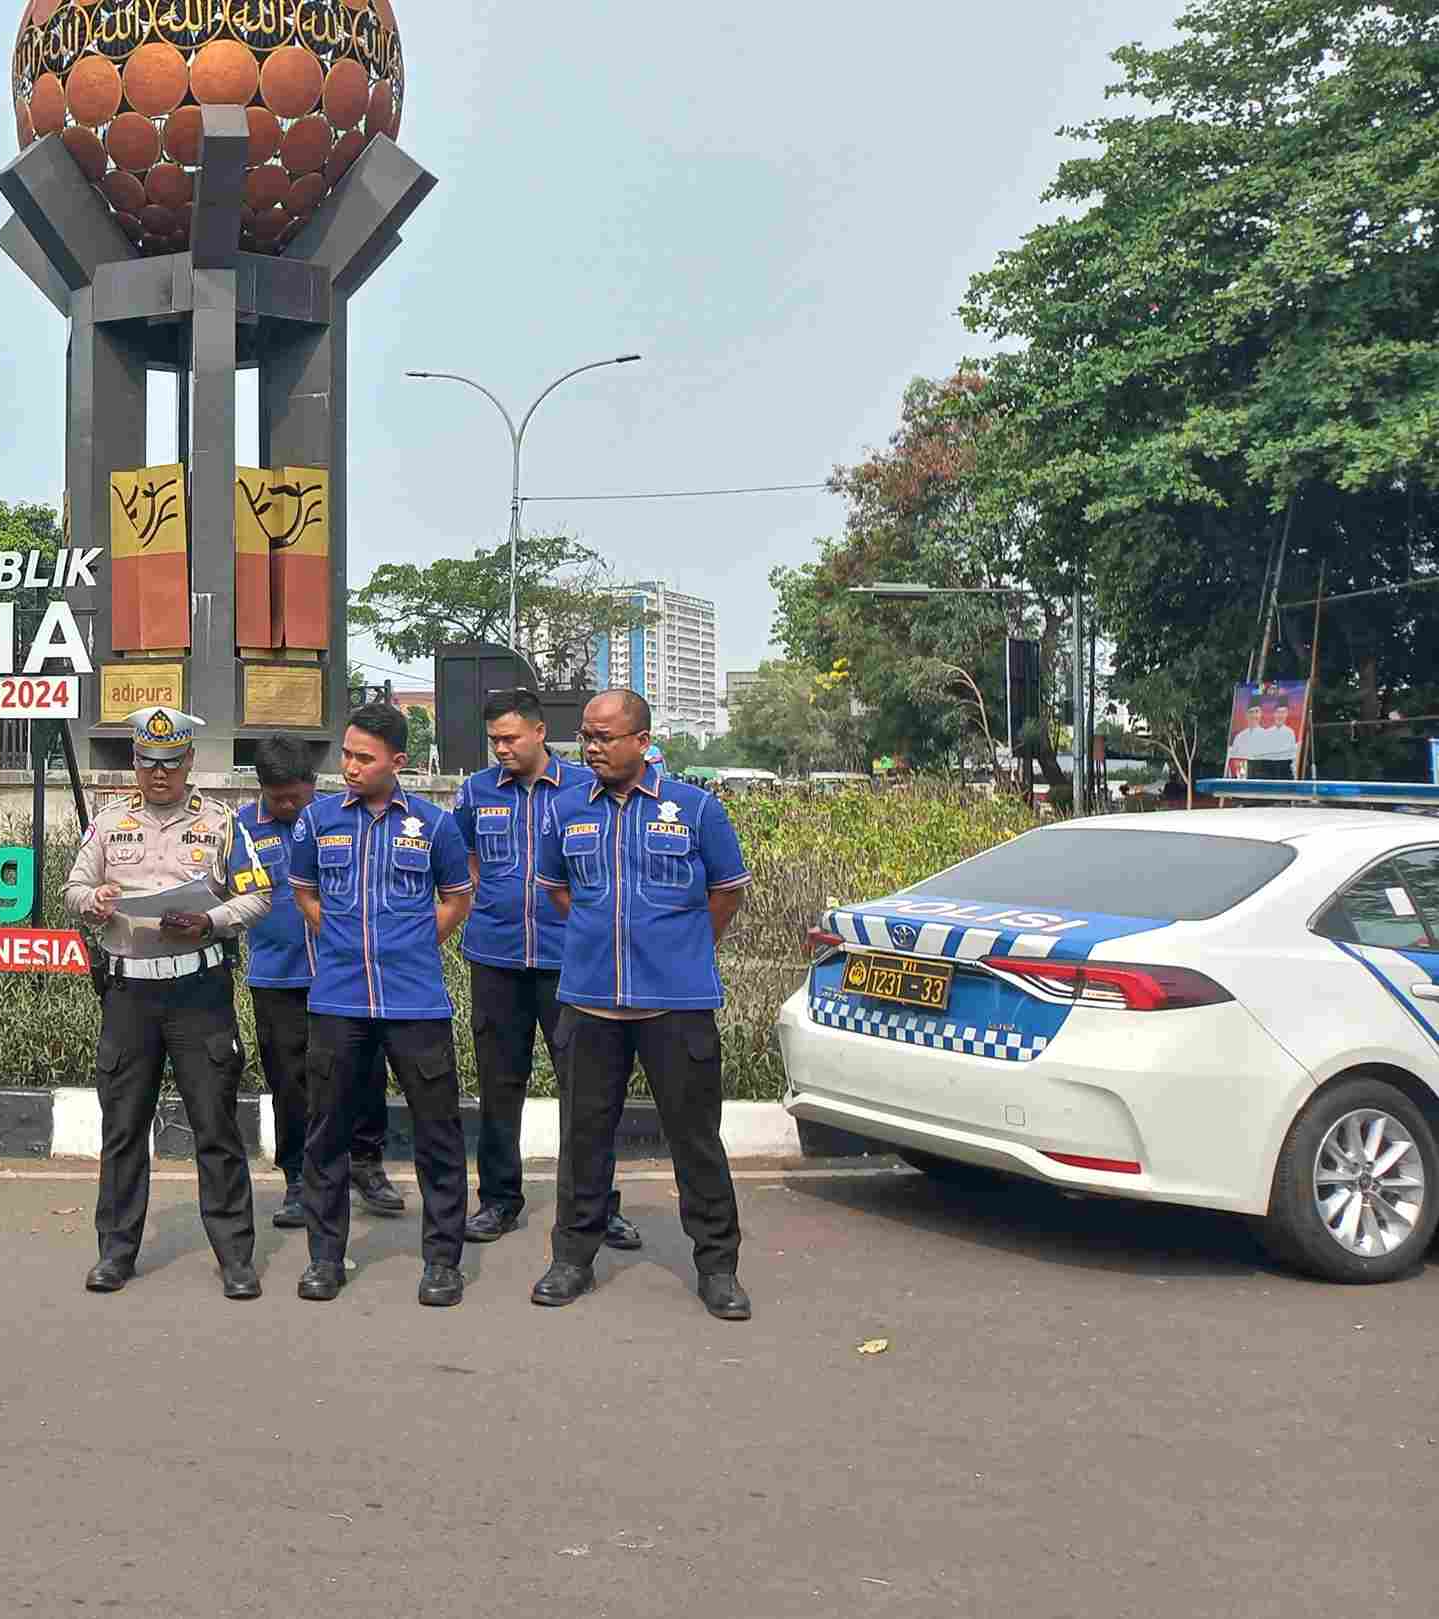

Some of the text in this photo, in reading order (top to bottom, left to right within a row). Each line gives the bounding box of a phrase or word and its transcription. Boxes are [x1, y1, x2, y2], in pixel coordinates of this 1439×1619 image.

[1, 680, 69, 708] 2024
[864, 897, 1090, 933] POLISI
[870, 969, 903, 995] 1231
[920, 978, 945, 1003] 33
